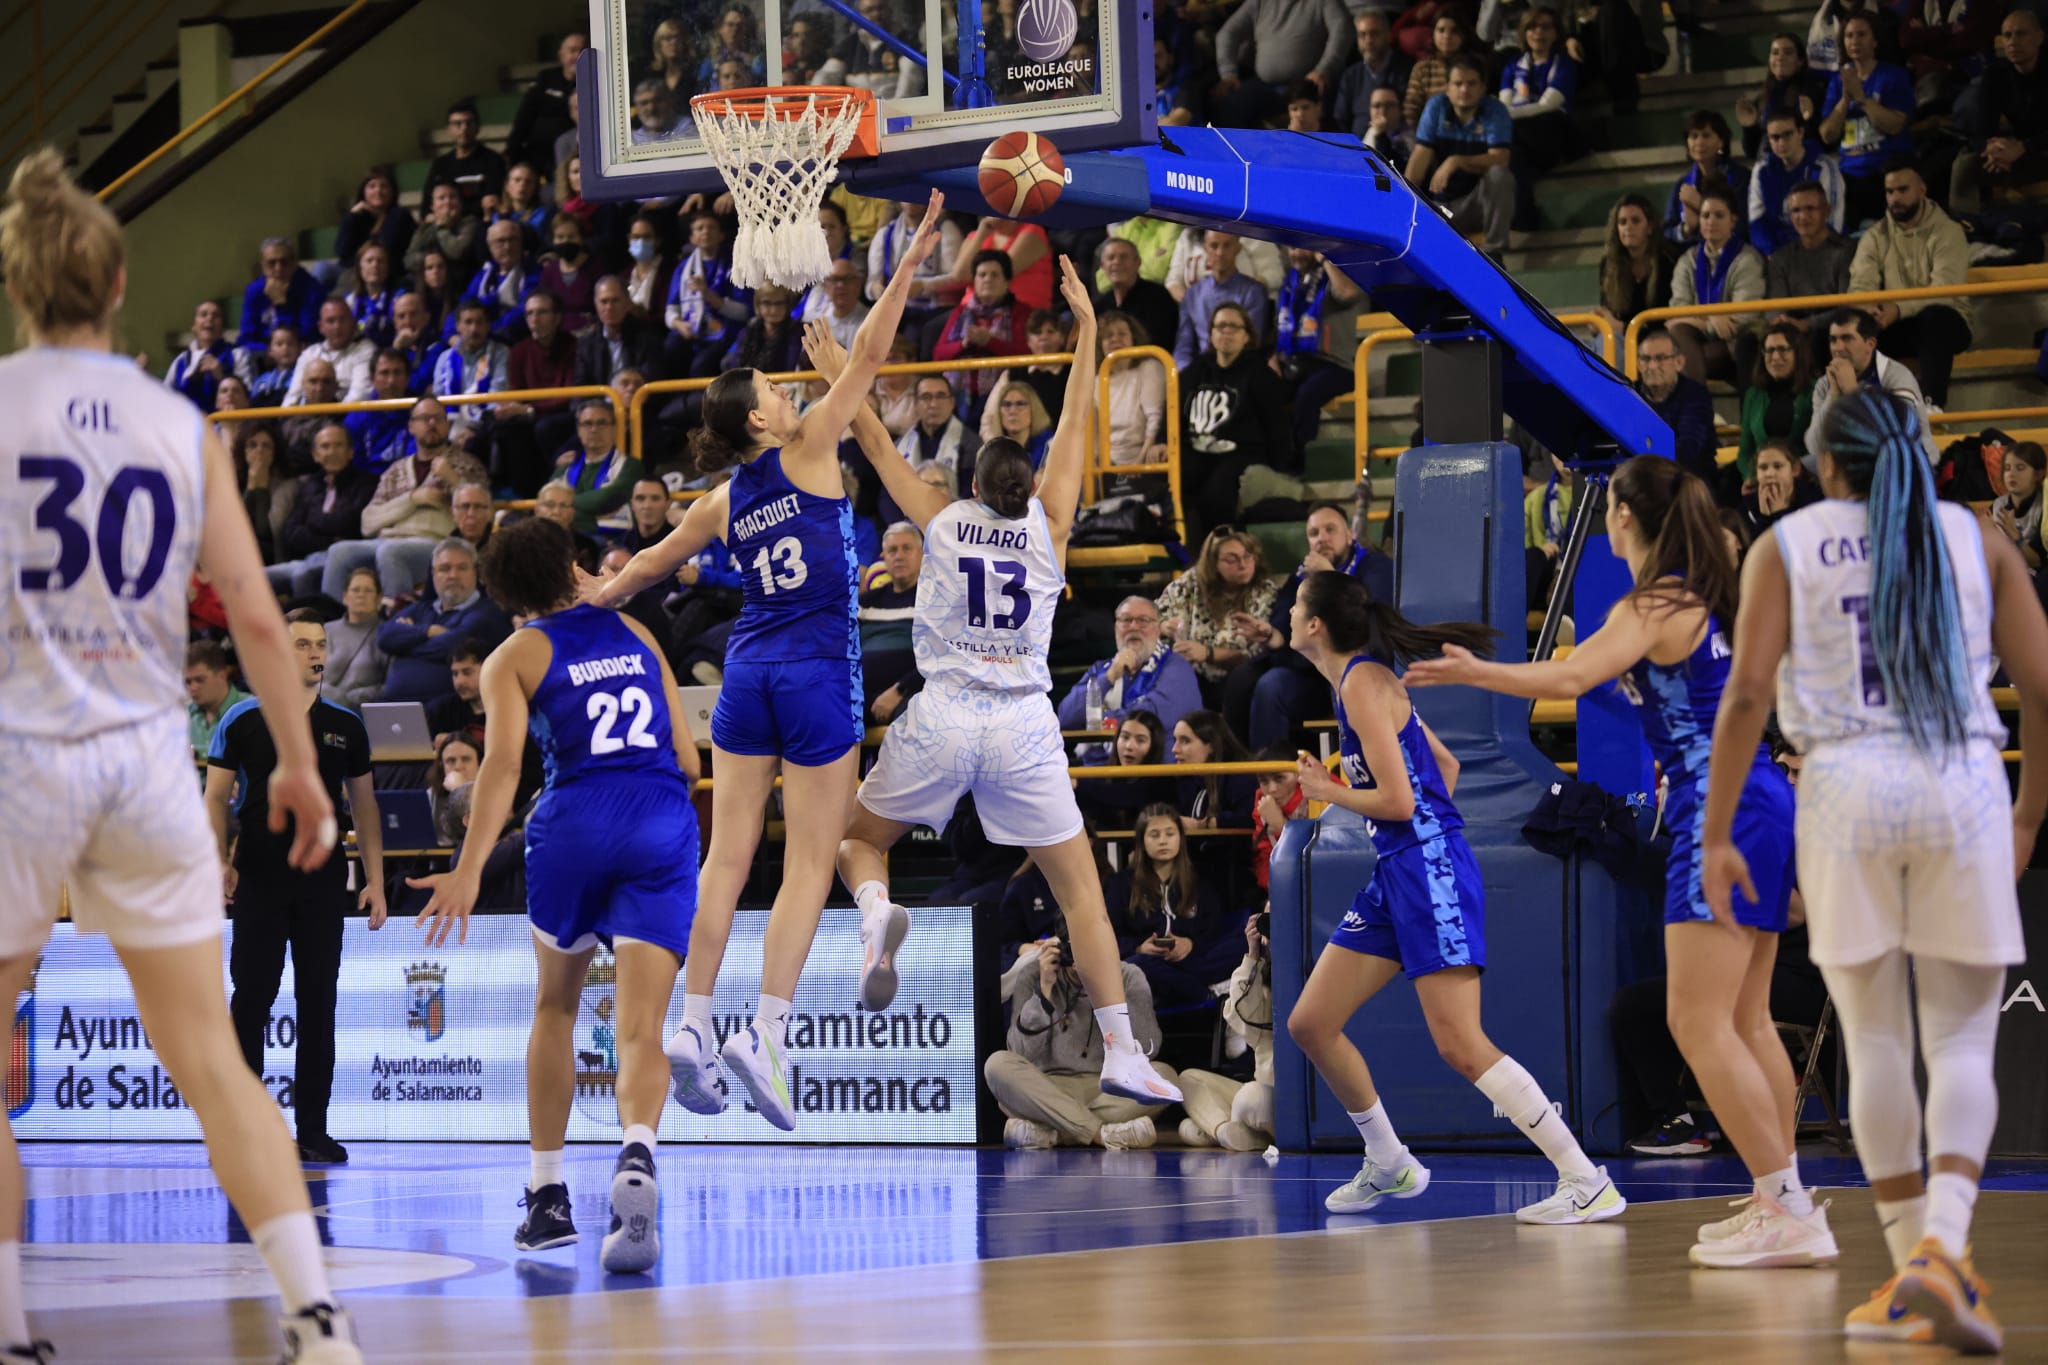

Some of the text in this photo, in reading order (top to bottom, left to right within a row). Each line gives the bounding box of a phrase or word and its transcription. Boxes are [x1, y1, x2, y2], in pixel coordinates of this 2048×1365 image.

[1007, 59, 1091, 80] EUROLEAGUE
[1023, 76, 1074, 94] WOMEN
[1166, 170, 1214, 195] MONDO
[67, 397, 121, 433] GIL
[19, 456, 176, 600] 30
[733, 493, 802, 541] MACQUET
[957, 521, 1028, 550] VILARÓ
[752, 536, 808, 596] 13
[958, 557, 1032, 631] 13
[1003, 645, 1012, 656] Y
[567, 654, 647, 687] BURDICK
[586, 686, 659, 755] 22
[912, 831, 934, 841] FILA
[372, 1053, 482, 1079] Ayuntamiento
[56, 1066, 95, 1110] de
[372, 1081, 482, 1101] de Salamanca
